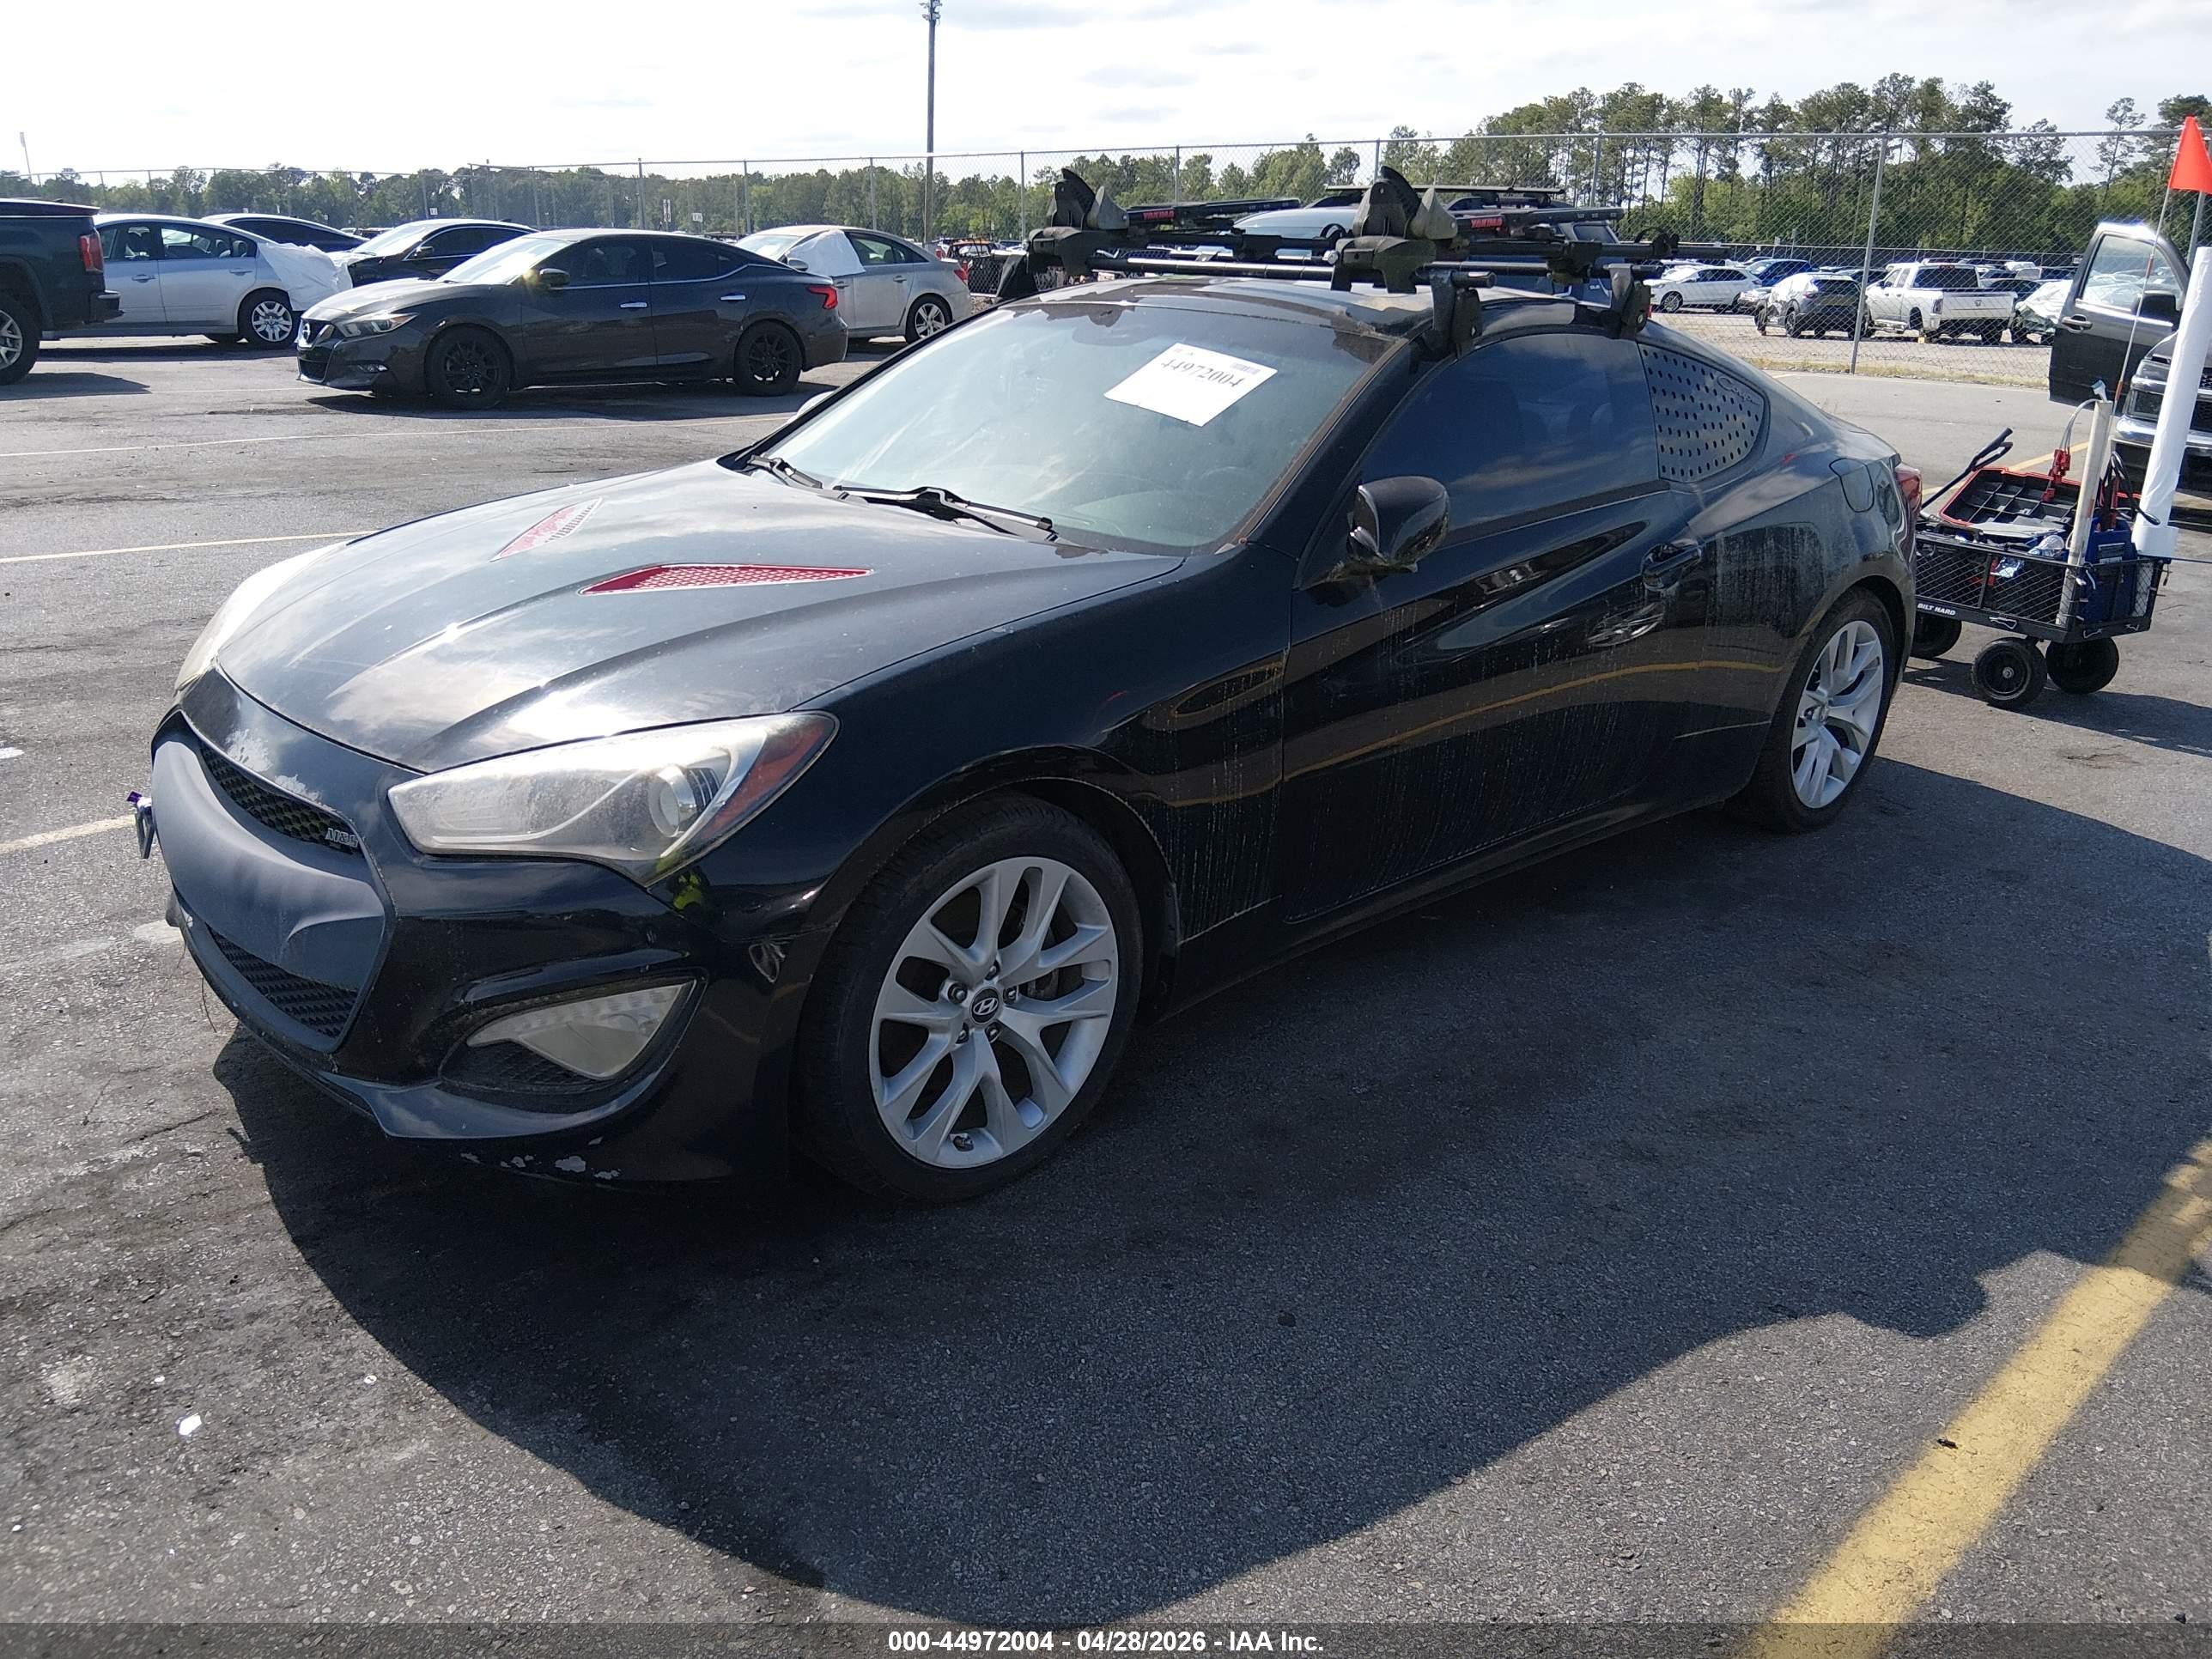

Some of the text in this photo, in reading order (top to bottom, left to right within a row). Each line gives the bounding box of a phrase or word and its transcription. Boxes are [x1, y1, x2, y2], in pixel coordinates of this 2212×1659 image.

[1471, 217, 1503, 228] YAKIMA
[1161, 359, 1245, 387] 44972004
[1934, 606, 1956, 616] HARD
